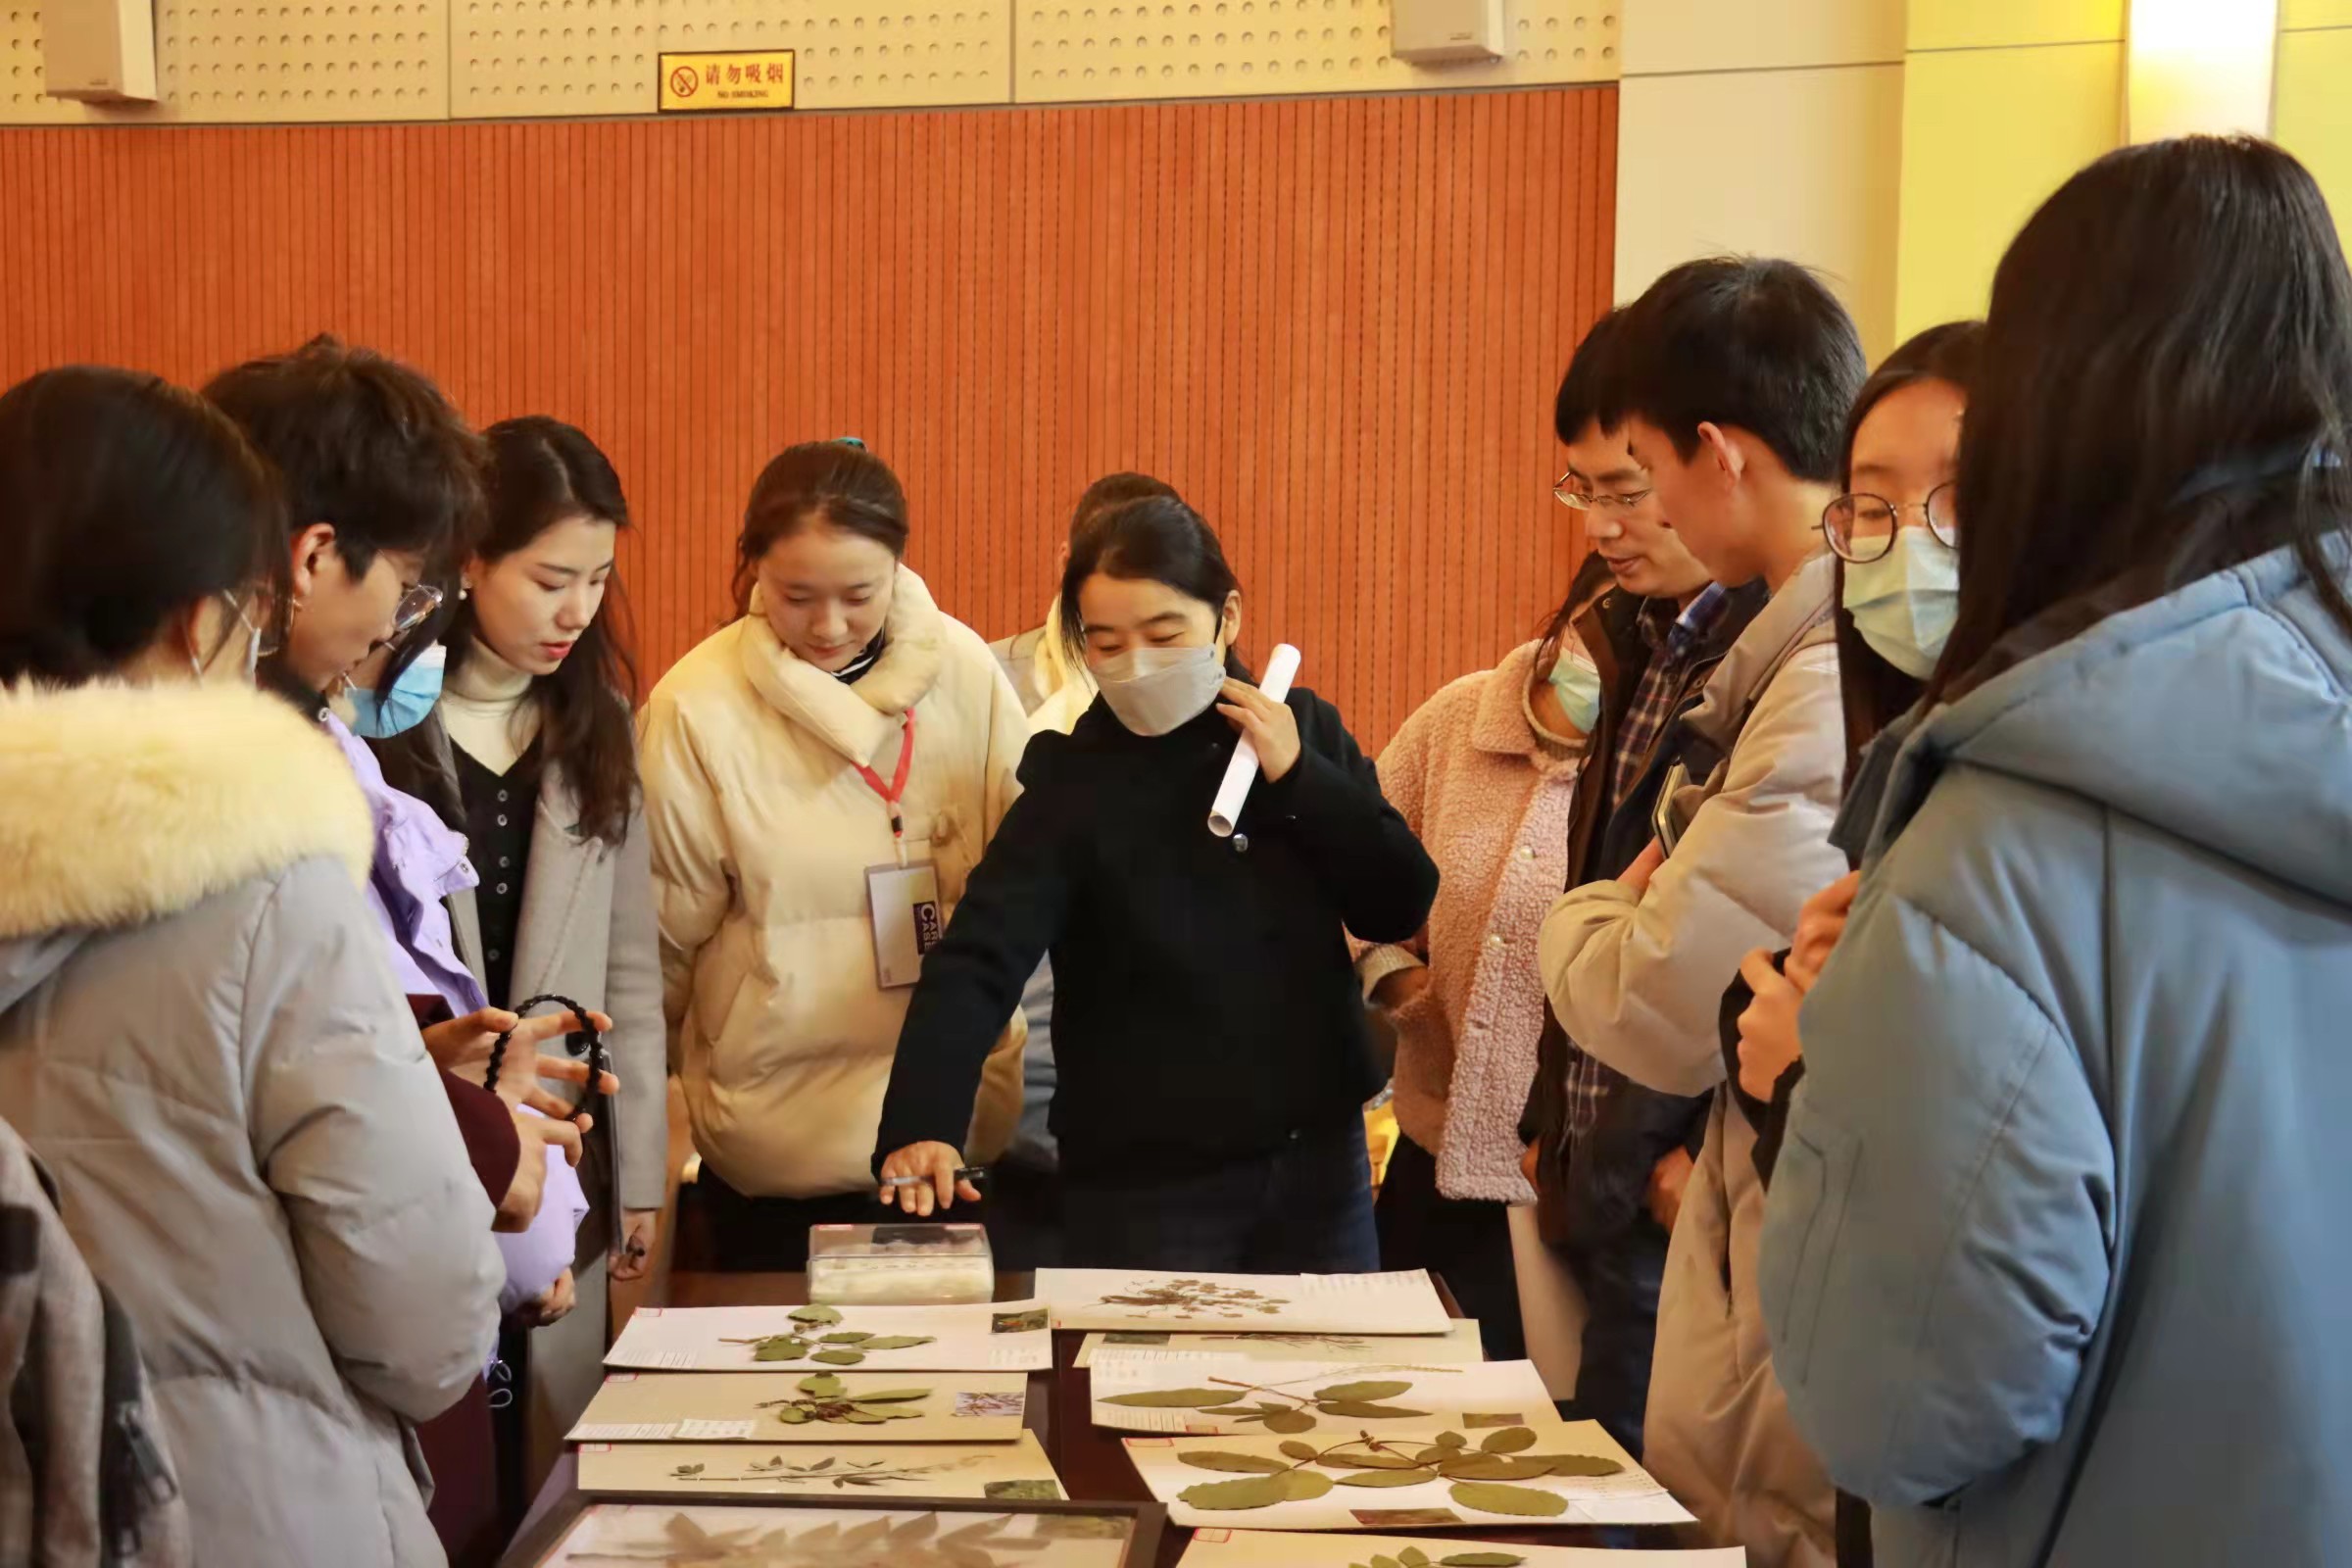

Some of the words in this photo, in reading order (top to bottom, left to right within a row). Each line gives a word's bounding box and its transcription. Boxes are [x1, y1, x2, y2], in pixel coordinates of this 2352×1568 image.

[705, 63, 784, 85] 请勿吸烟
[717, 90, 729, 99] NO
[731, 89, 769, 98] SMOKING
